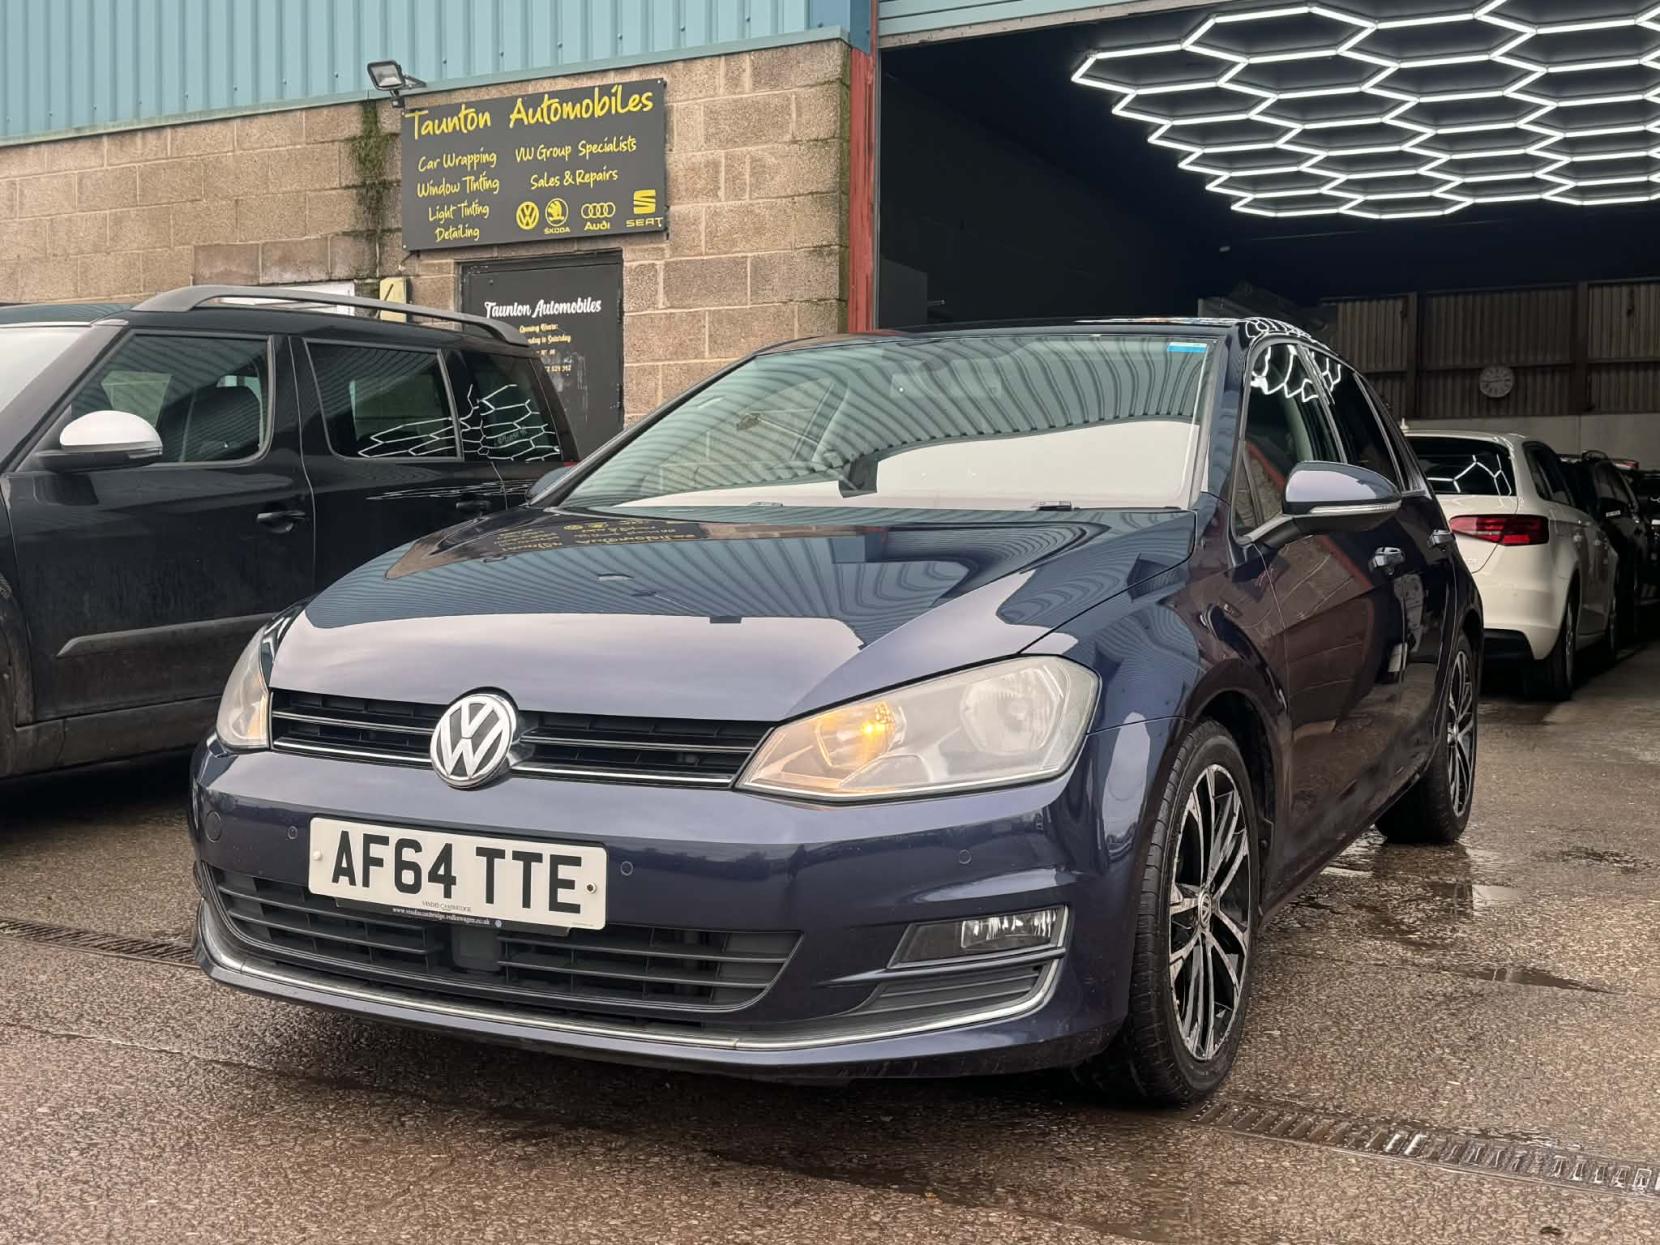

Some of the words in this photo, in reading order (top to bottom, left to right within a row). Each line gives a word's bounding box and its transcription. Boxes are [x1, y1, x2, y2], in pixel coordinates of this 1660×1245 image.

[405, 104, 491, 140] Taunton
[509, 85, 653, 128] Automobiles
[418, 156, 440, 172] Car
[442, 147, 497, 171] Wrapping
[515, 148, 535, 162] VW
[537, 144, 572, 161] Group
[578, 135, 637, 157] Specialists
[417, 177, 460, 197] Window
[462, 171, 499, 194] Tinting
[530, 173, 560, 190] Sales
[563, 172, 575, 186] &
[576, 167, 618, 188] Repairs
[428, 204, 456, 223] Light
[457, 199, 489, 218] Tinting
[626, 217, 663, 228] SEAT
[435, 224, 480, 242] Detailing
[584, 220, 611, 231] Audi
[484, 301, 532, 318] Taunton
[532, 297, 602, 318] Automobiles
[331, 830, 457, 900] AF64
[475, 846, 583, 914] TTE
